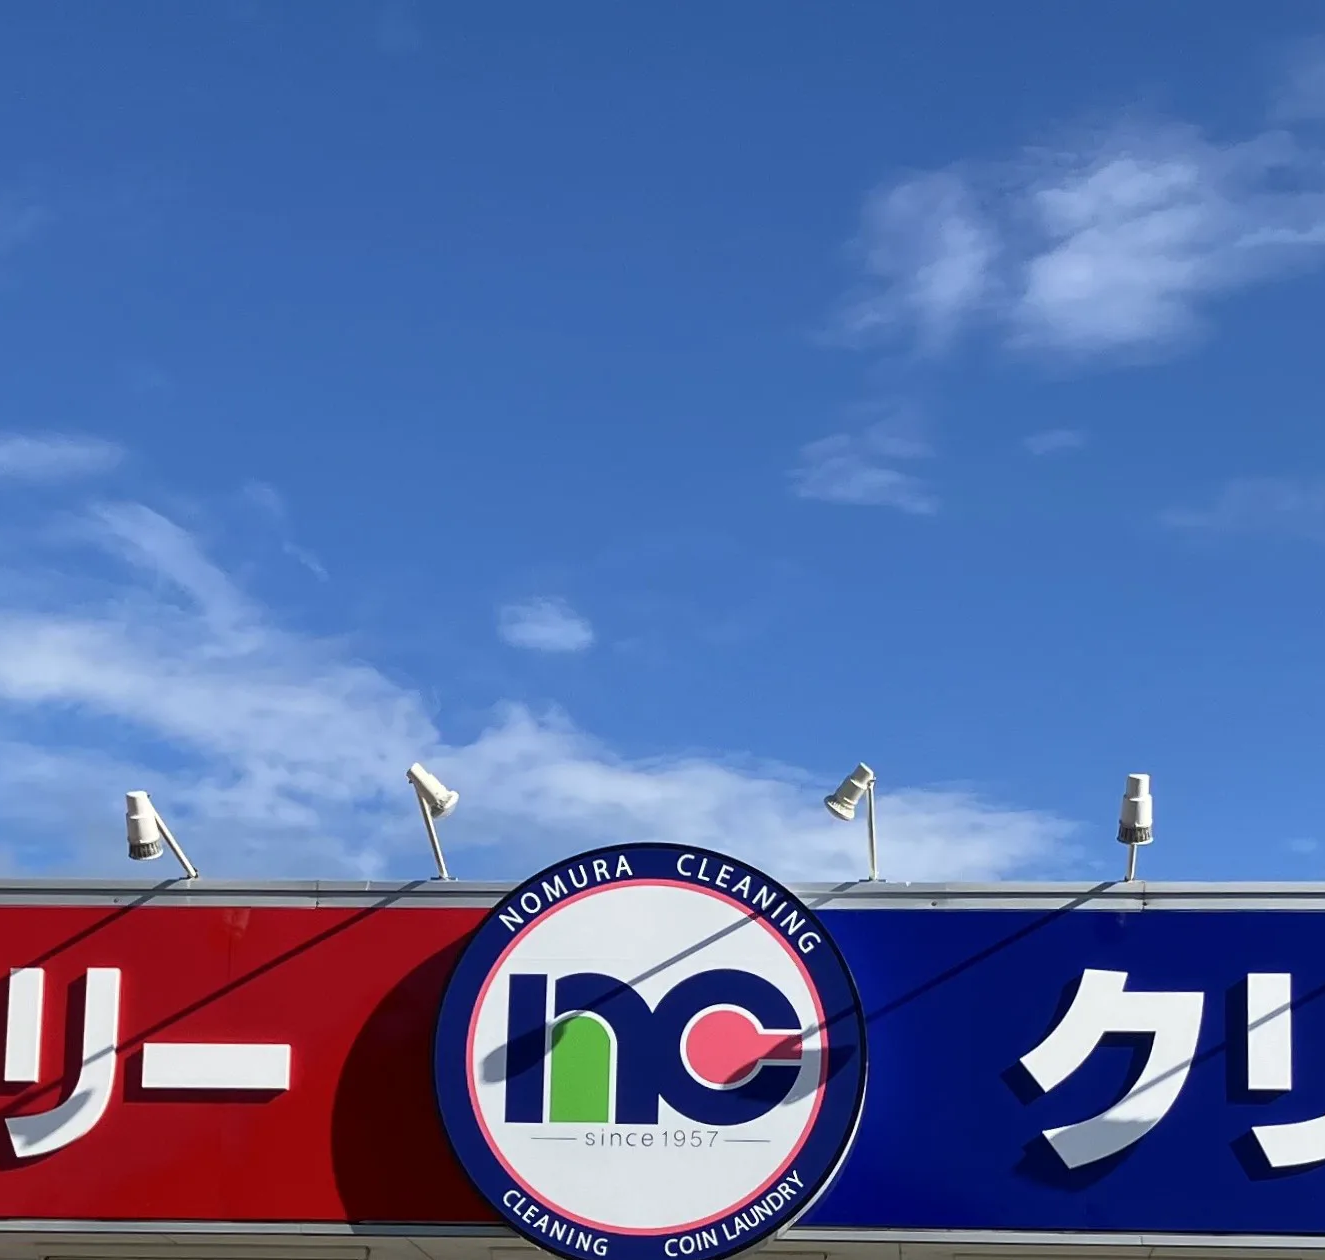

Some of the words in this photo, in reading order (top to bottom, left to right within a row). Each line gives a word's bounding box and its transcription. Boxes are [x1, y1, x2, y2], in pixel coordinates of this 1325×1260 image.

[499, 854, 633, 932] NOMURA
[676, 853, 821, 954] CLEANING
[584, 1129, 654, 1148] since
[661, 1130, 720, 1148] 1957
[503, 1189, 608, 1257] CLEANING
[663, 1230, 718, 1258] COIN
[722, 1170, 805, 1243] LAUNDRY
